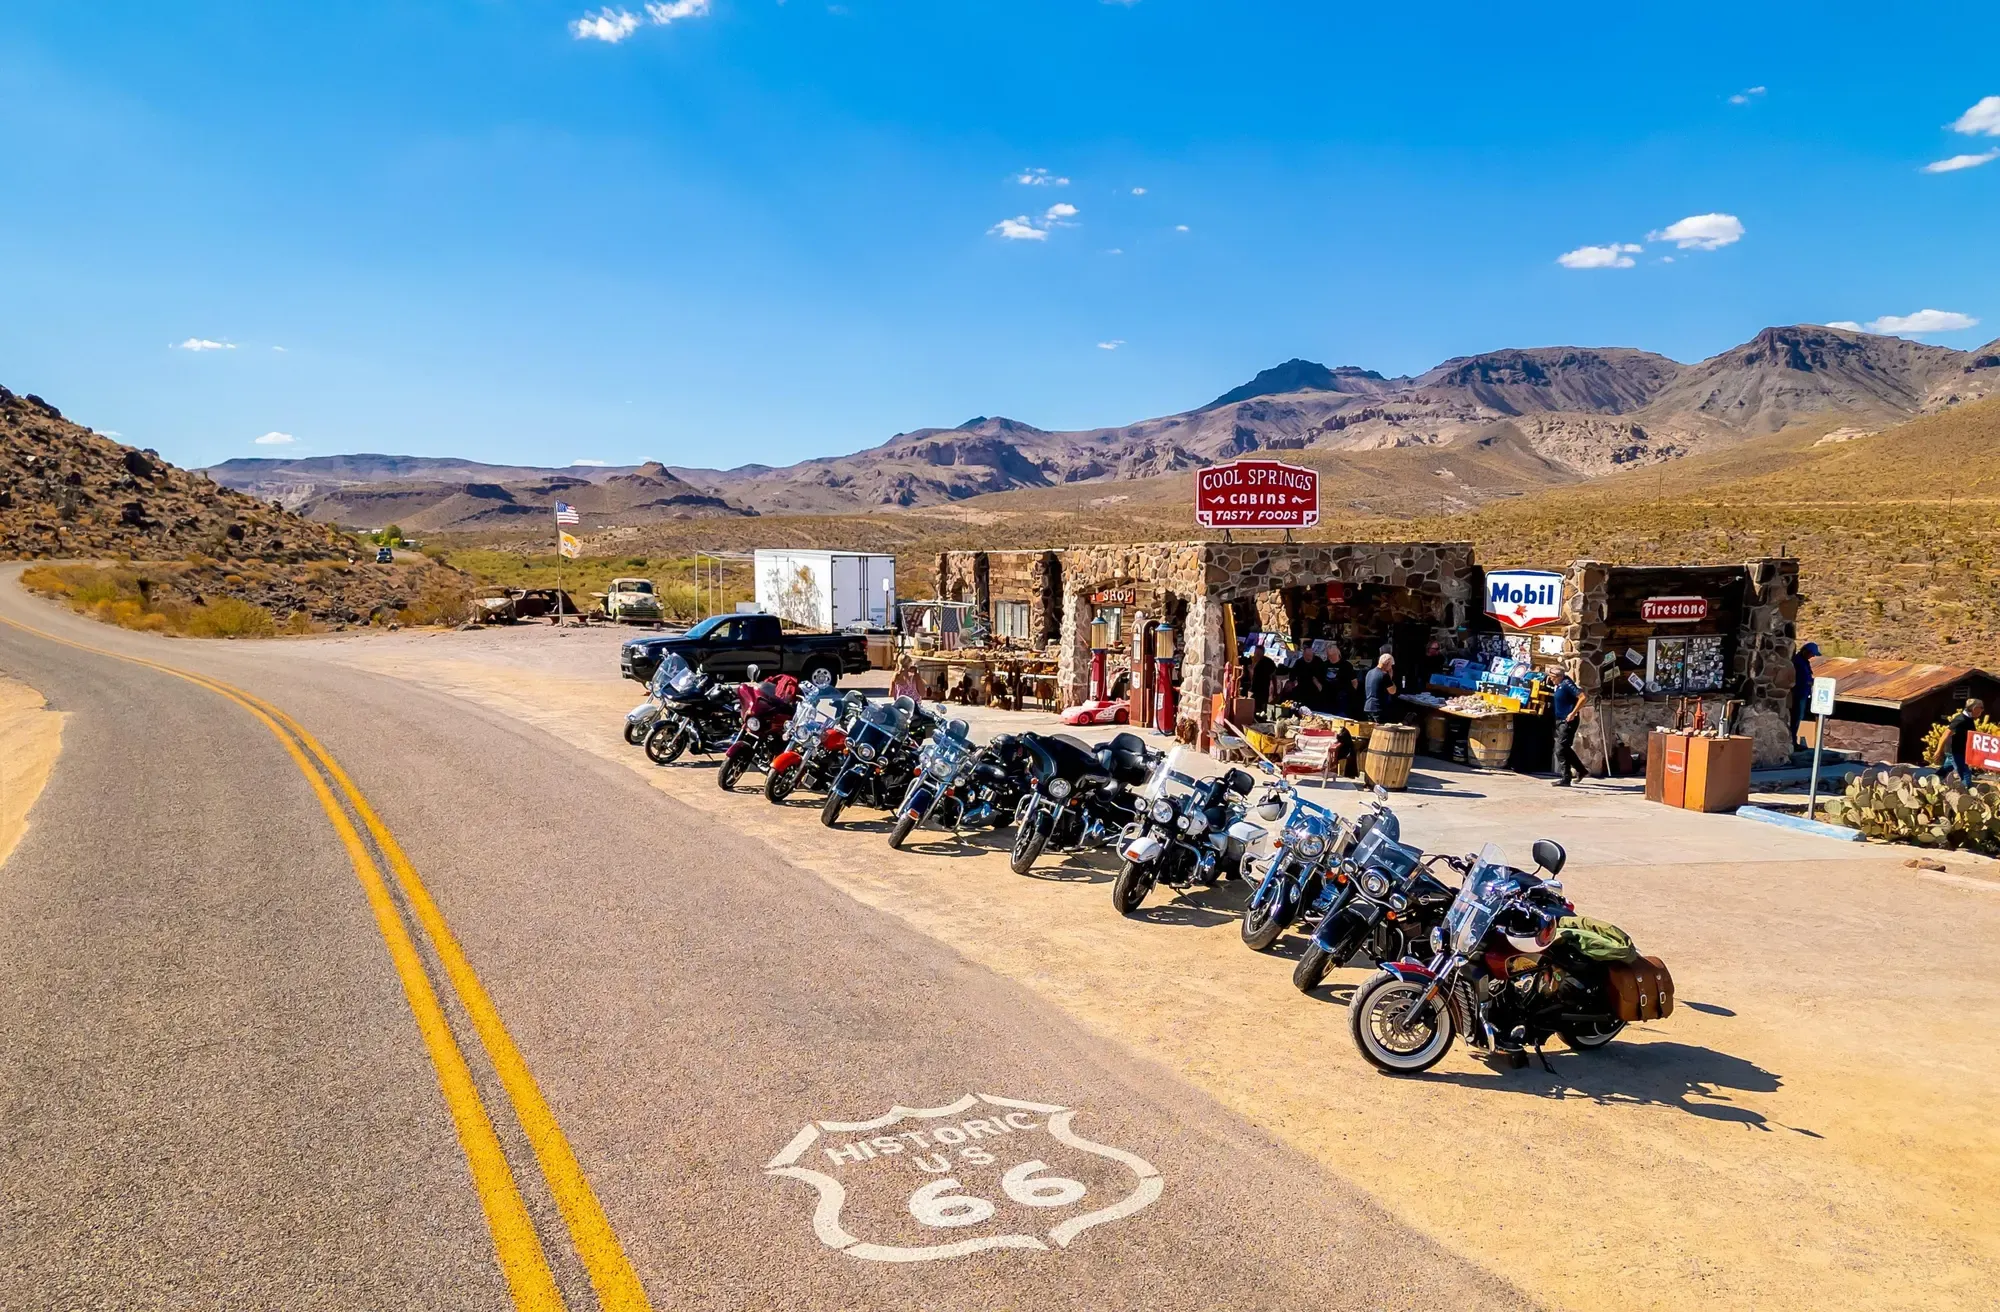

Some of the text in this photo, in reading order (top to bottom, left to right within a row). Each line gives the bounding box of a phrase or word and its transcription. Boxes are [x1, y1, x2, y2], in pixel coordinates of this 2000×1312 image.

[1203, 469, 1313, 491] COOL SPRINGS
[1230, 493, 1286, 505] CABINS
[1216, 510, 1298, 521] TASTY FOODS
[1103, 589, 1131, 601] SHOP
[1491, 582, 1554, 605] Mobil
[1643, 602, 1706, 617] Firestone
[825, 1112, 1040, 1166] HISTORIC
[909, 1159, 1087, 1228] 66
